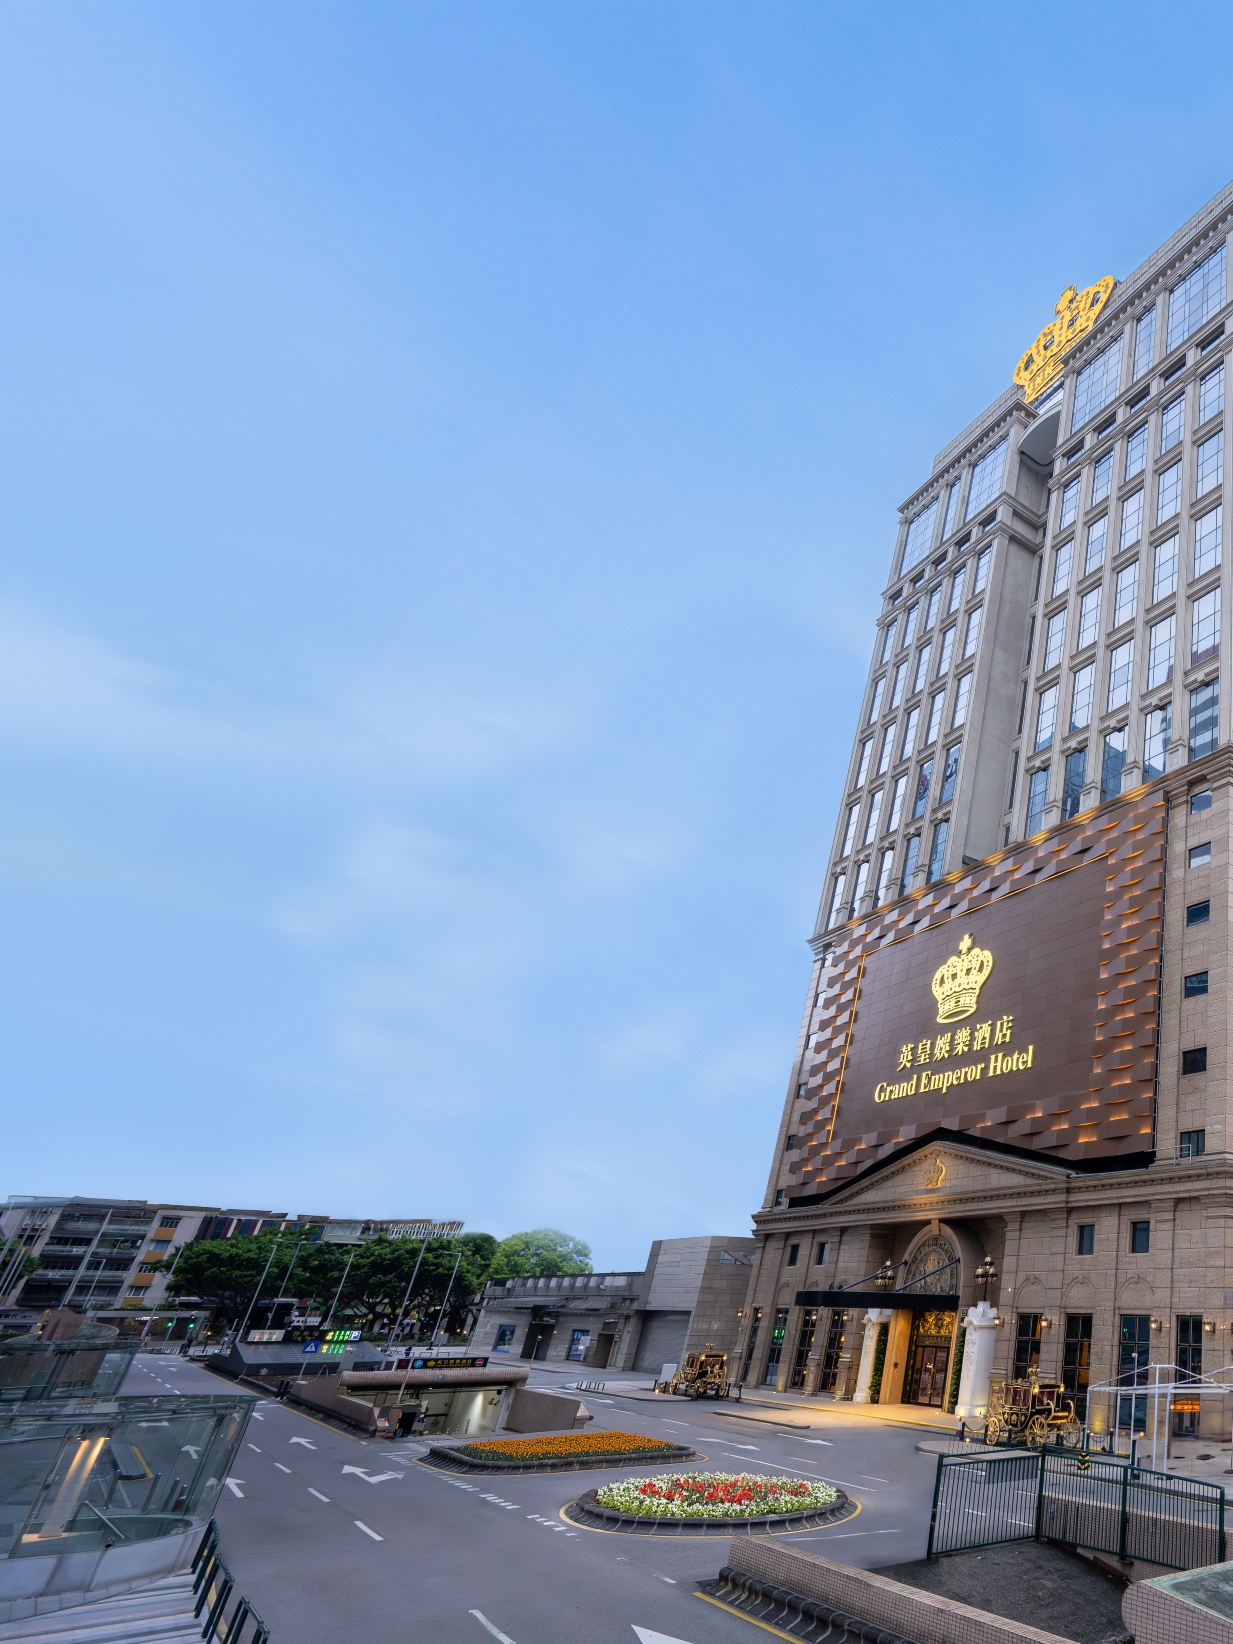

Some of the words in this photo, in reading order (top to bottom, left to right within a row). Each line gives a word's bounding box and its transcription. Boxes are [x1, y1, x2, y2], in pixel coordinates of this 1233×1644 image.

[896, 1015, 1014, 1072] 英皇娛樂酒店
[874, 1074, 917, 1103] Grand
[918, 1061, 985, 1094] Emperor
[987, 1044, 1034, 1077] Hotel
[351, 1331, 359, 1340] P
